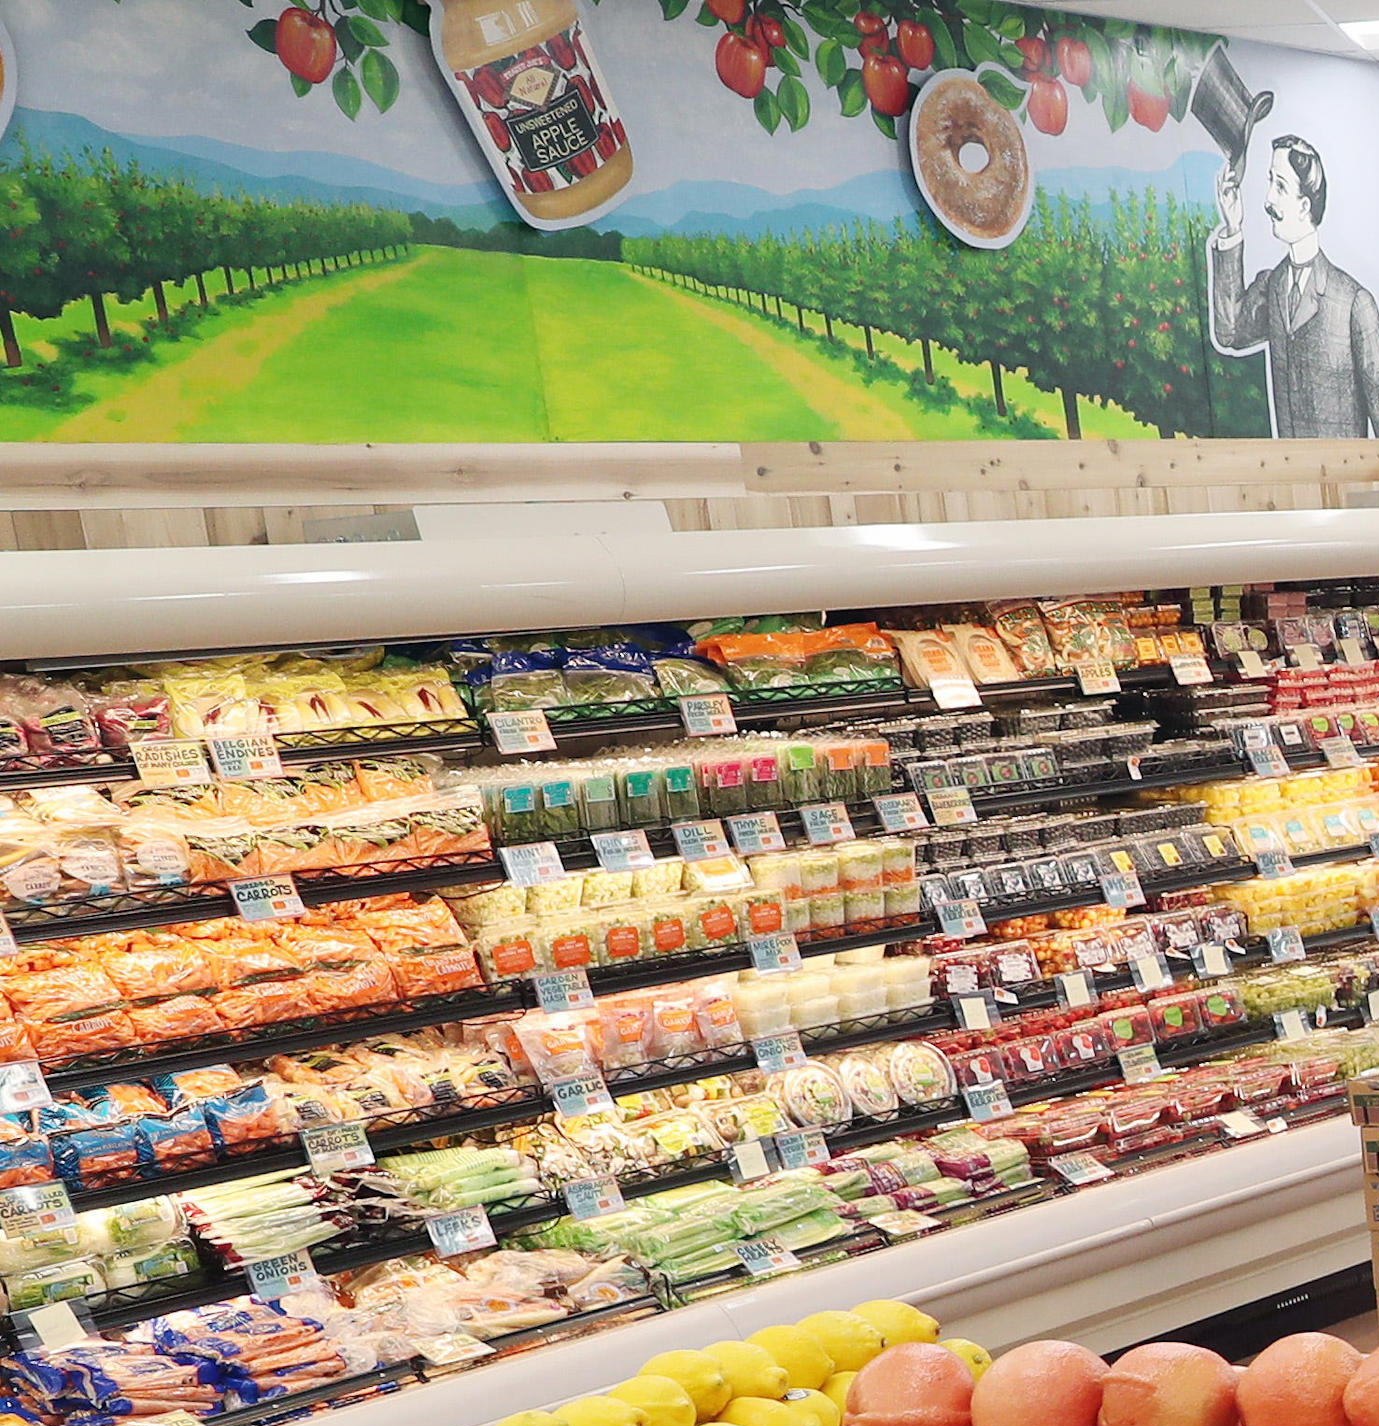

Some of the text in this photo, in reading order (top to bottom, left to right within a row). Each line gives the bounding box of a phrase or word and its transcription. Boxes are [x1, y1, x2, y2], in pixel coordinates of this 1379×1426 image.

[514, 100, 579, 135] UNSWEETENED
[530, 117, 580, 151] APPLE
[536, 131, 589, 164] SAUCE
[212, 738, 269, 751] BELGIAN
[135, 749, 199, 763] RADISHES
[216, 747, 275, 760] ENDIVES
[810, 808, 838, 820] SAGE
[682, 827, 712, 838] DILL
[733, 819, 766, 831] THYME
[236, 884, 293, 902] CARROTS
[309, 1133, 360, 1150] CARROTS
[435, 1216, 481, 1236] LEEKS
[251, 1253, 298, 1271] GREEN
[255, 1262, 308, 1281] ONIONS
